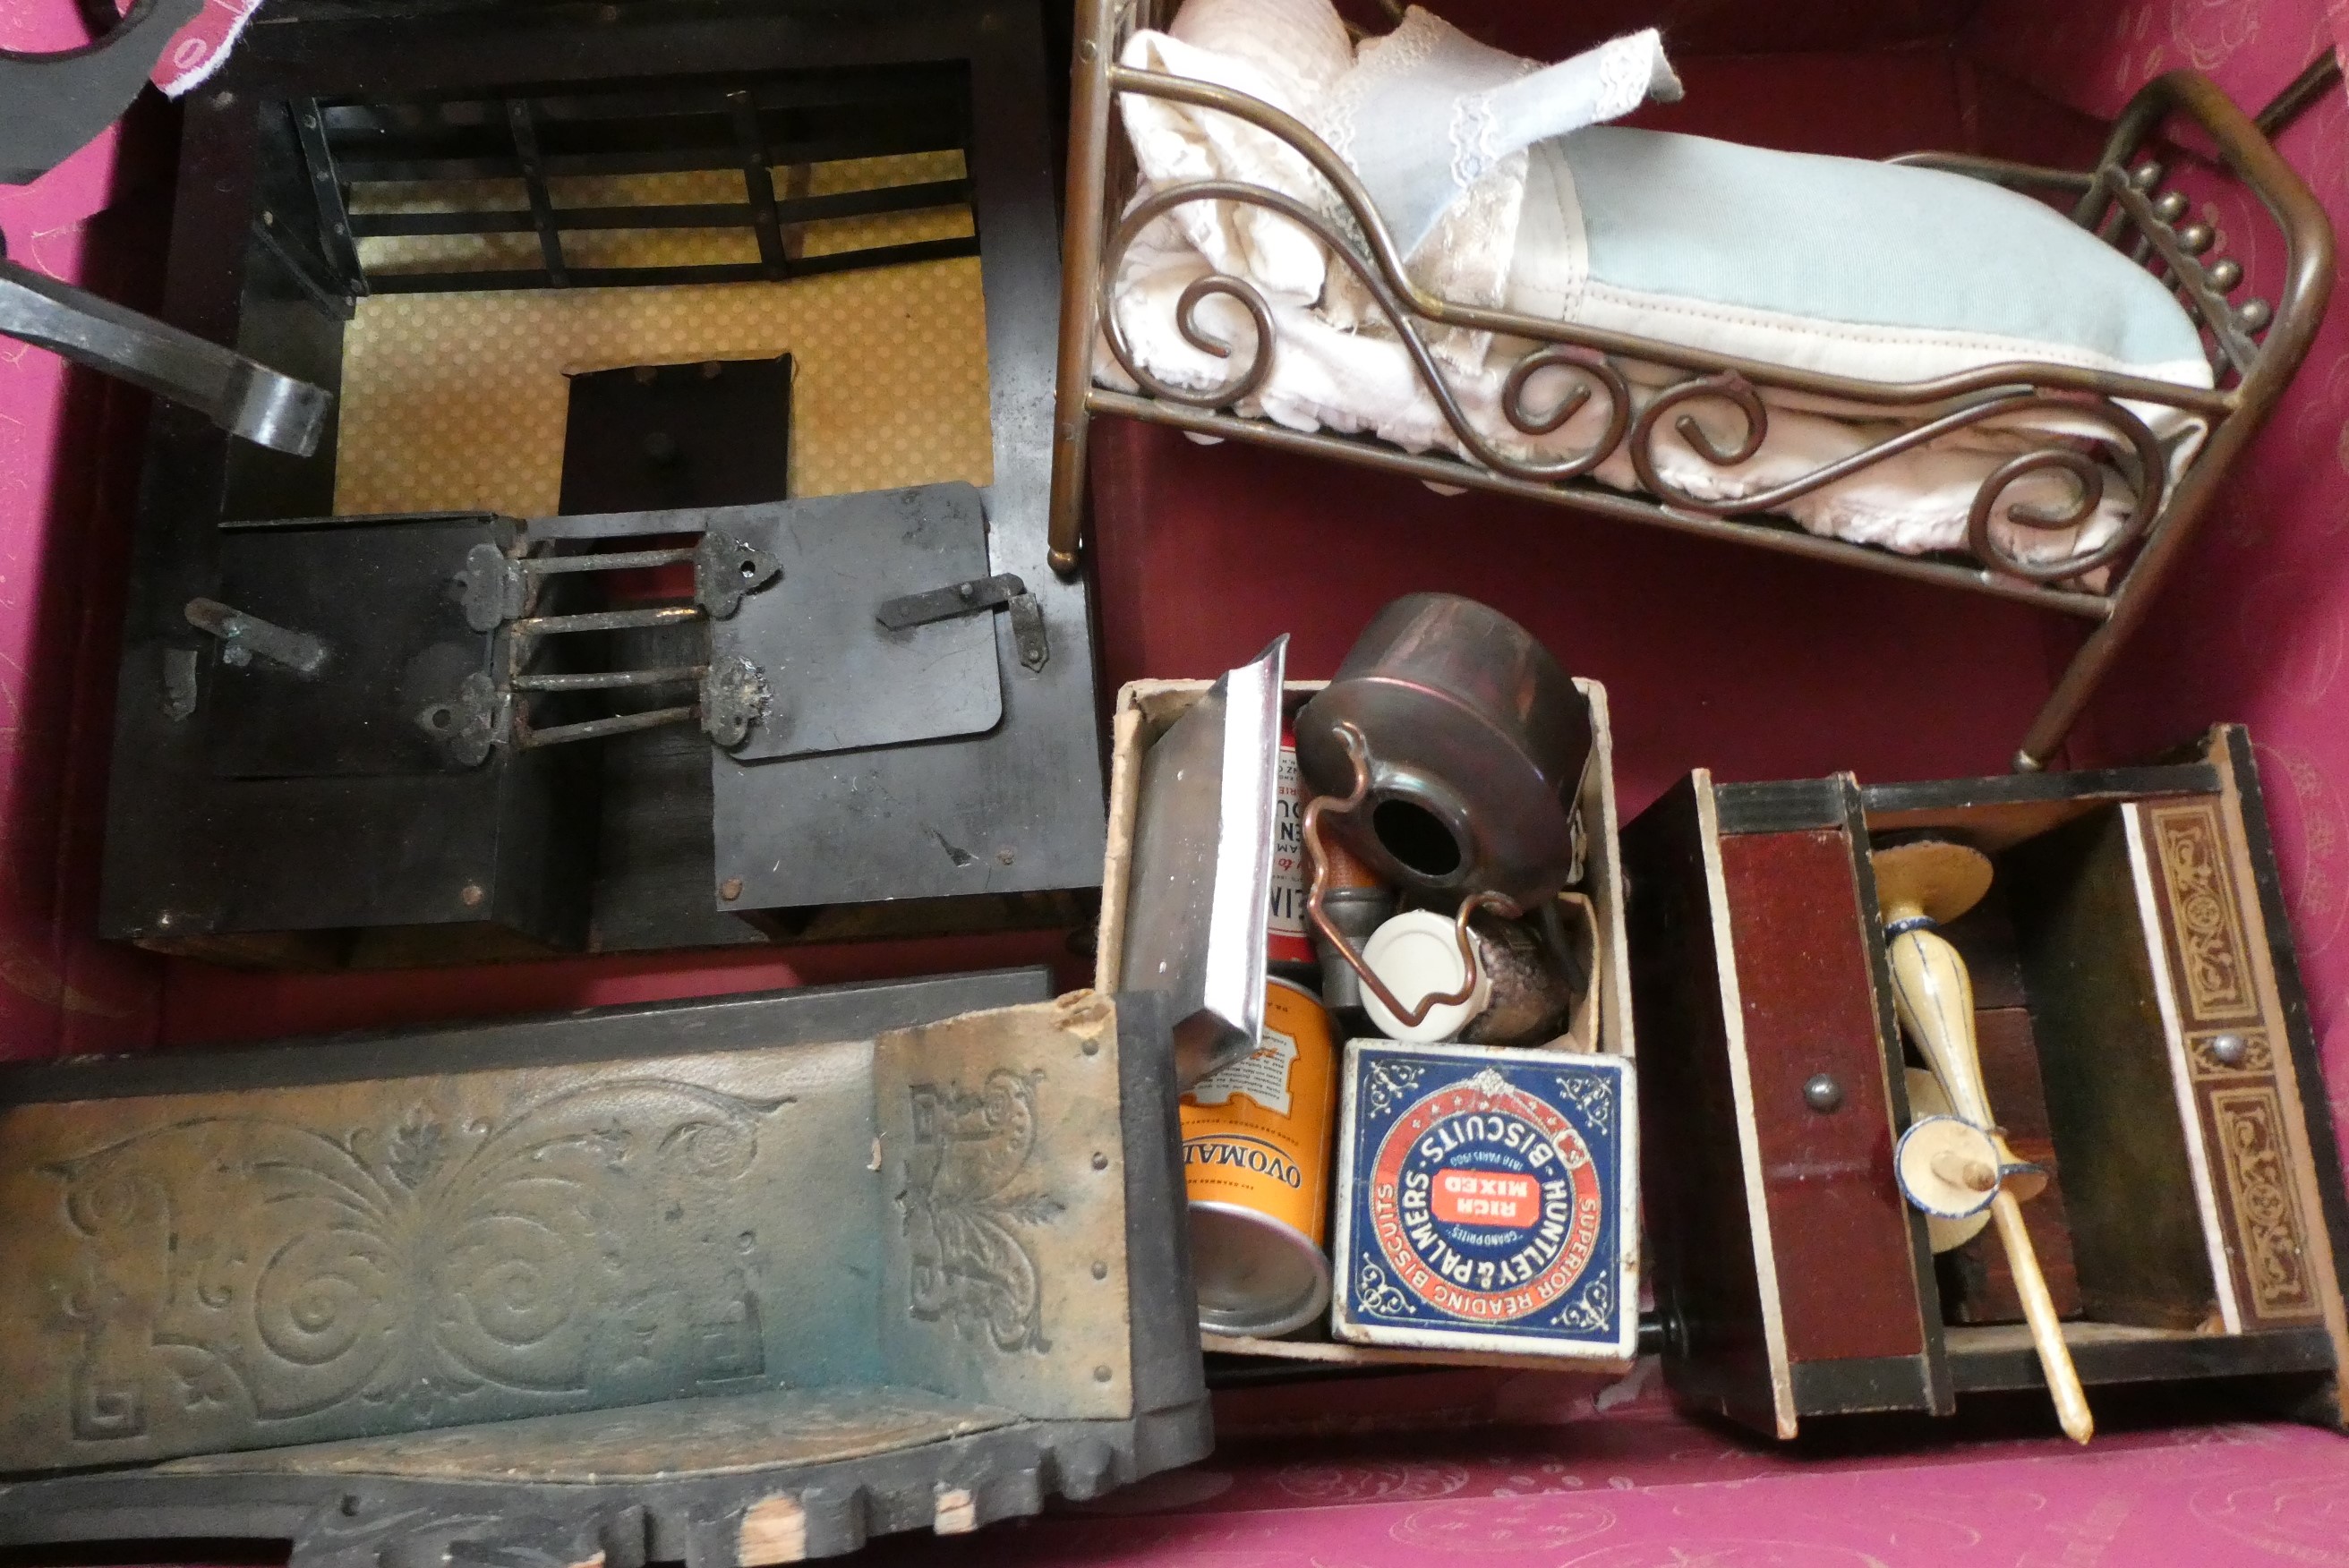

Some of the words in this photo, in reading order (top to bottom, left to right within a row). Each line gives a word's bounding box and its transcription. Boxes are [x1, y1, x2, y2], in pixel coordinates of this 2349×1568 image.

[1420, 1115, 1554, 1169] BISCUITS
[1444, 1176, 1528, 1197] MIXED
[1456, 1197, 1517, 1218] RICH
[1377, 1181, 1430, 1290] BISCUITS
[1402, 1171, 1474, 1283] PALMERS
[1498, 1179, 1567, 1286] HUNTLEY
[1538, 1196, 1596, 1300] SUPERIOR
[1433, 1284, 1533, 1315] READING
[1477, 1261, 1496, 1289] &
